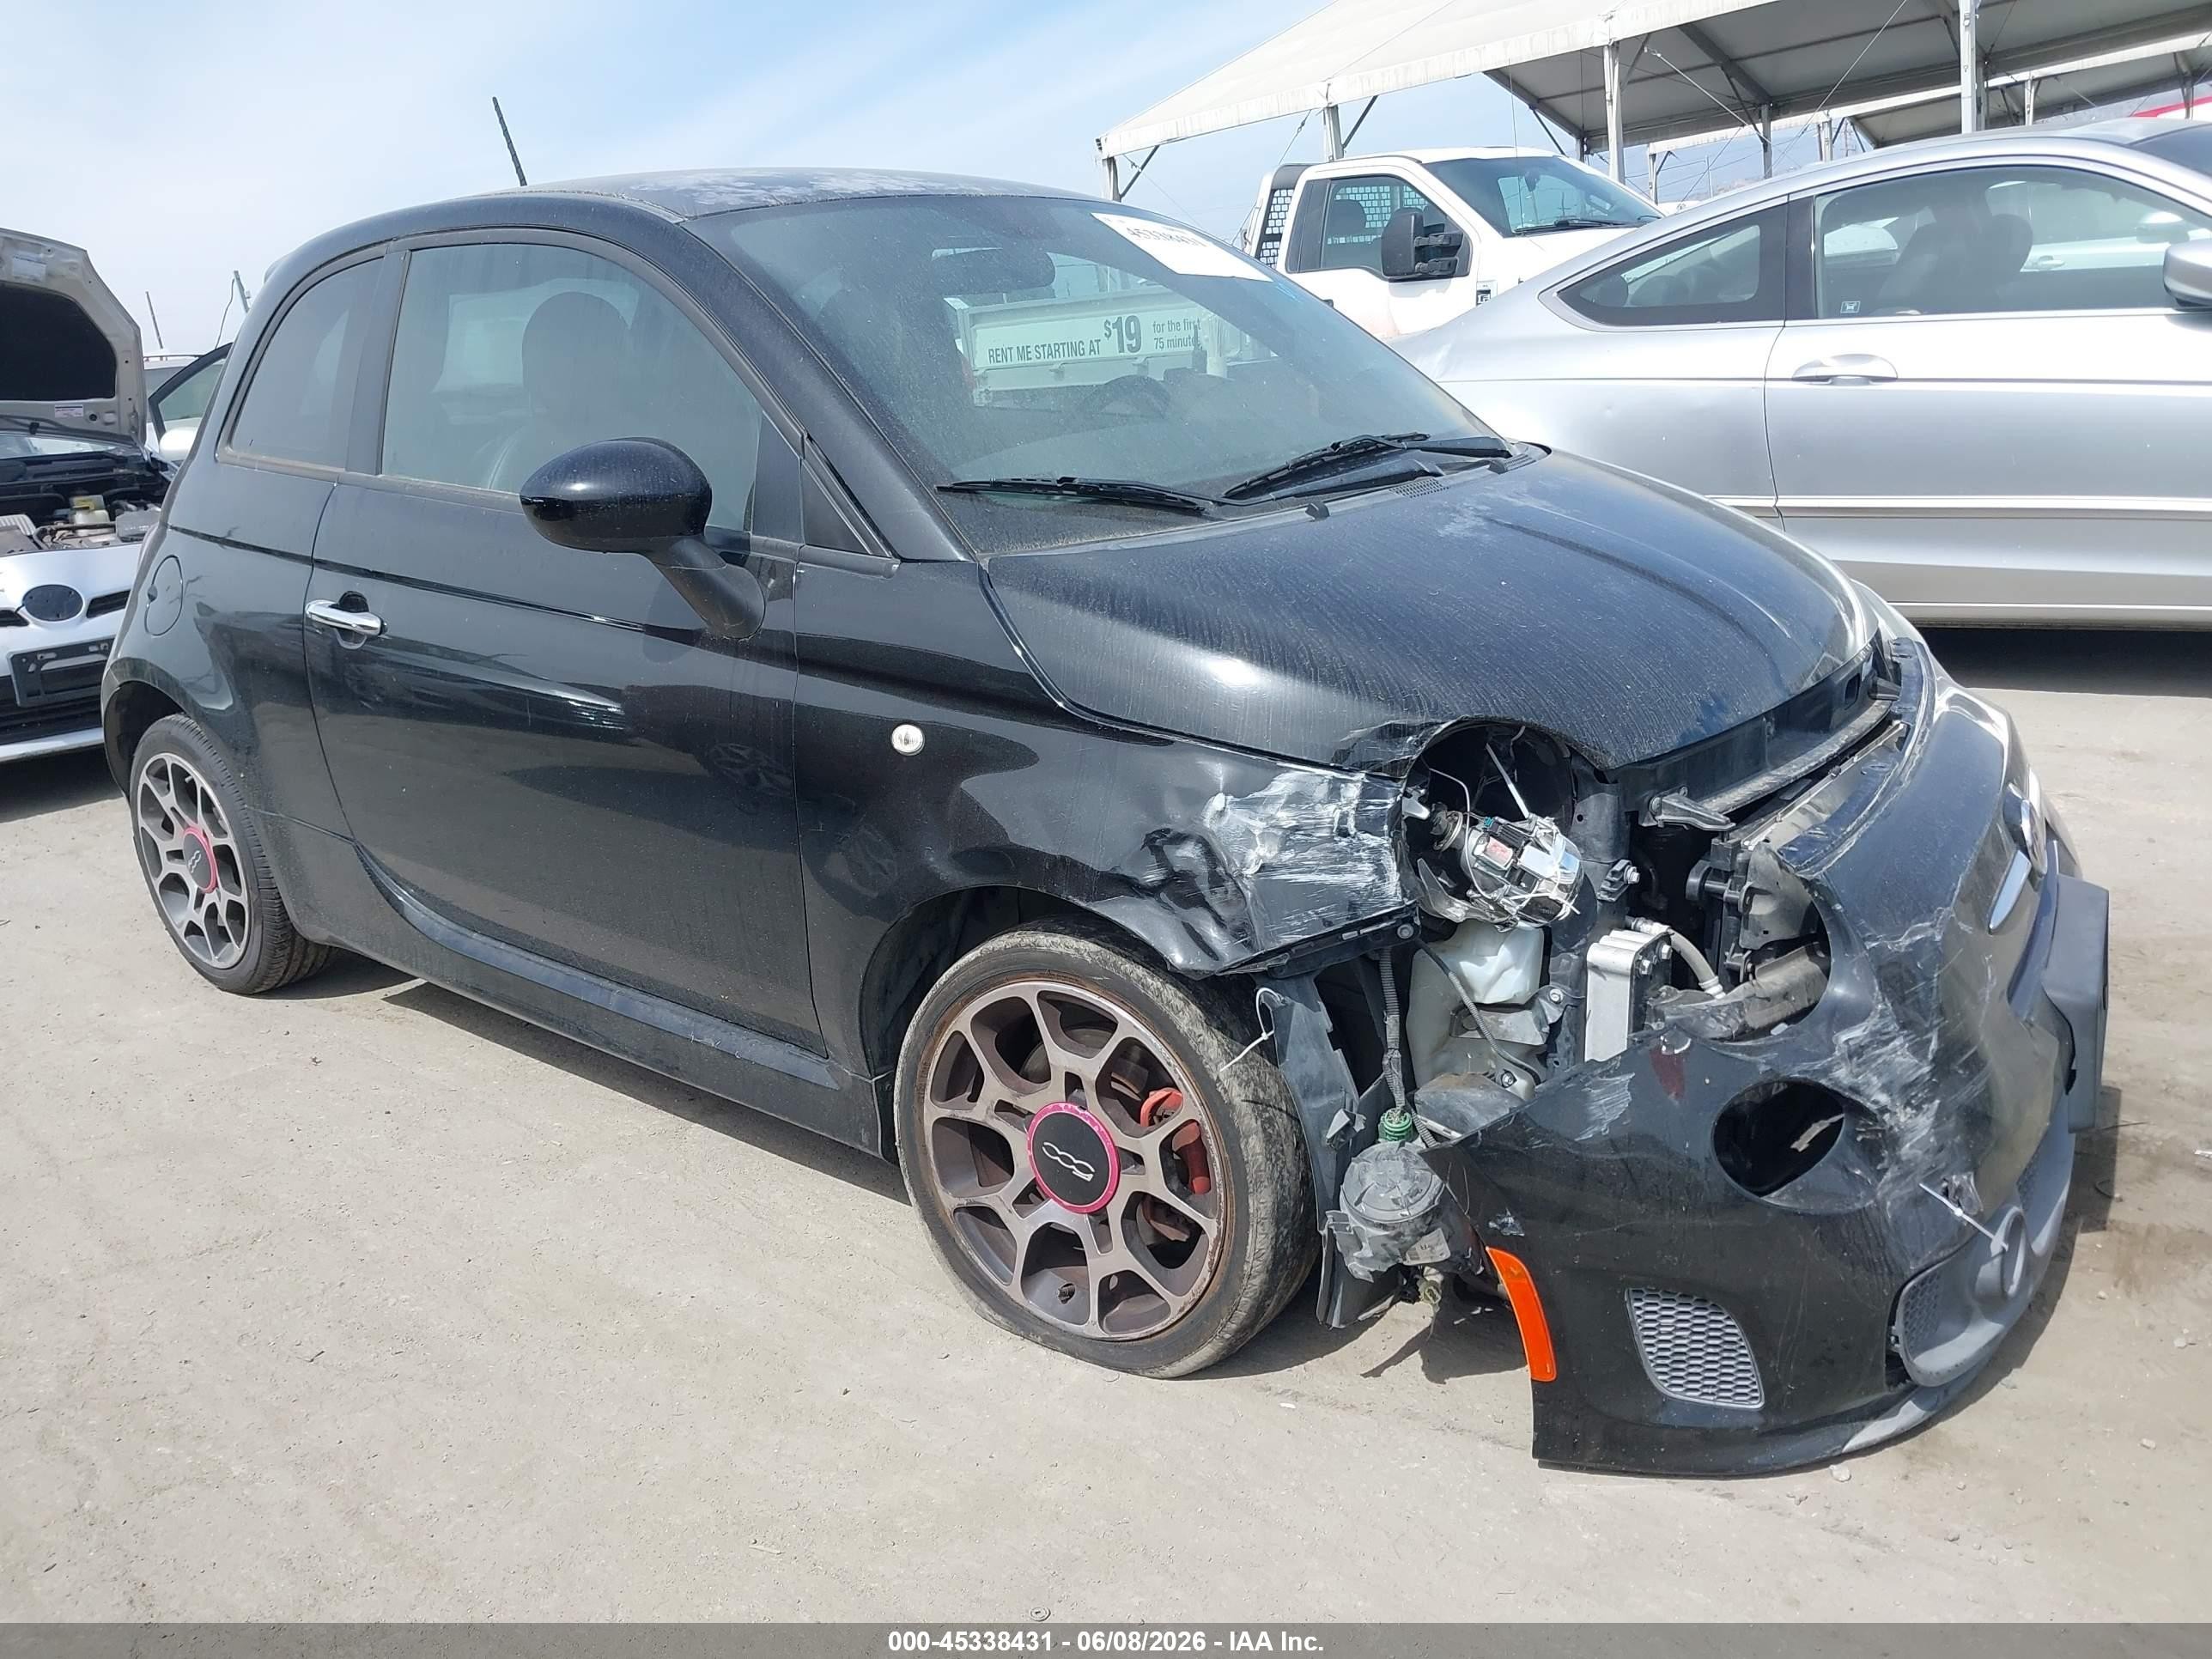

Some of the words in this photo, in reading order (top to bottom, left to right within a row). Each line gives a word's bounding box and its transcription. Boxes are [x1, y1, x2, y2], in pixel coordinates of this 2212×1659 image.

[1152, 321, 1165, 333] for
[1168, 319, 1181, 331] the
[988, 346, 1013, 364] RENT
[1017, 345, 1032, 362] ME
[1035, 340, 1085, 360] STARTING
[1089, 339, 1101, 356] AT
[1103, 315, 1142, 353] $19
[1154, 337, 1164, 349] 75
[1167, 335, 1200, 349] minute
